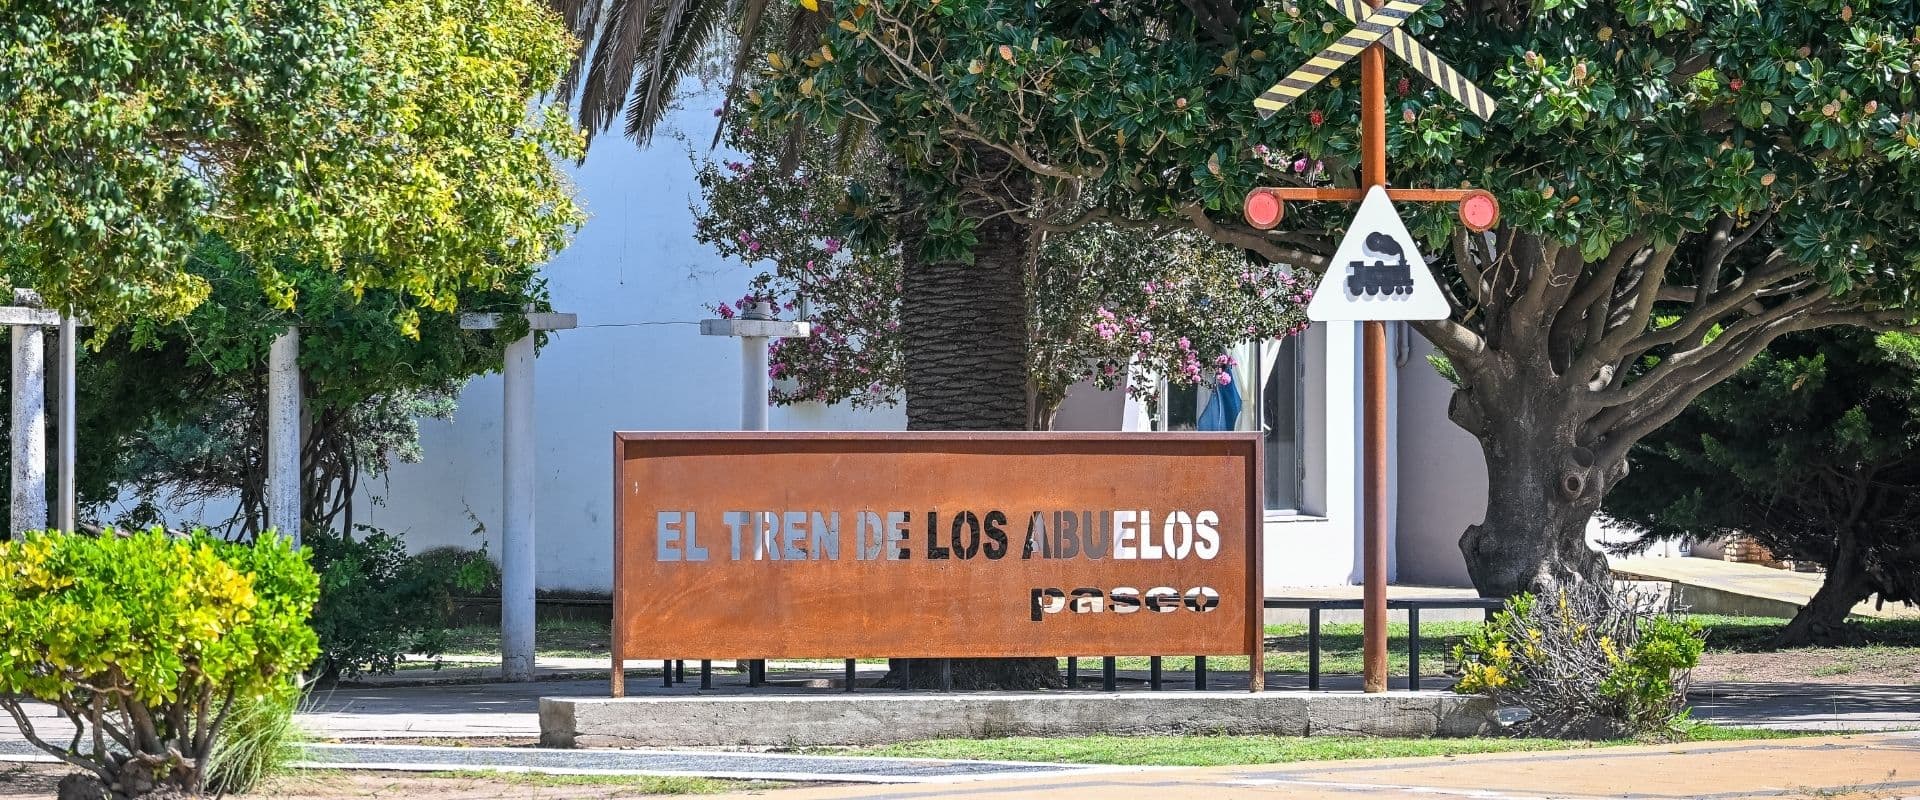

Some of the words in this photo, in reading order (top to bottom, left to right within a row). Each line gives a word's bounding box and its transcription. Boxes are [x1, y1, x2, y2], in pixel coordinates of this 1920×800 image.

[656, 511, 709, 562] EL
[723, 511, 839, 562] TREN
[856, 511, 910, 561] DE
[928, 511, 1008, 560] LOS
[1021, 510, 1220, 560] ABUELOS
[1031, 587, 1219, 621] paseo
